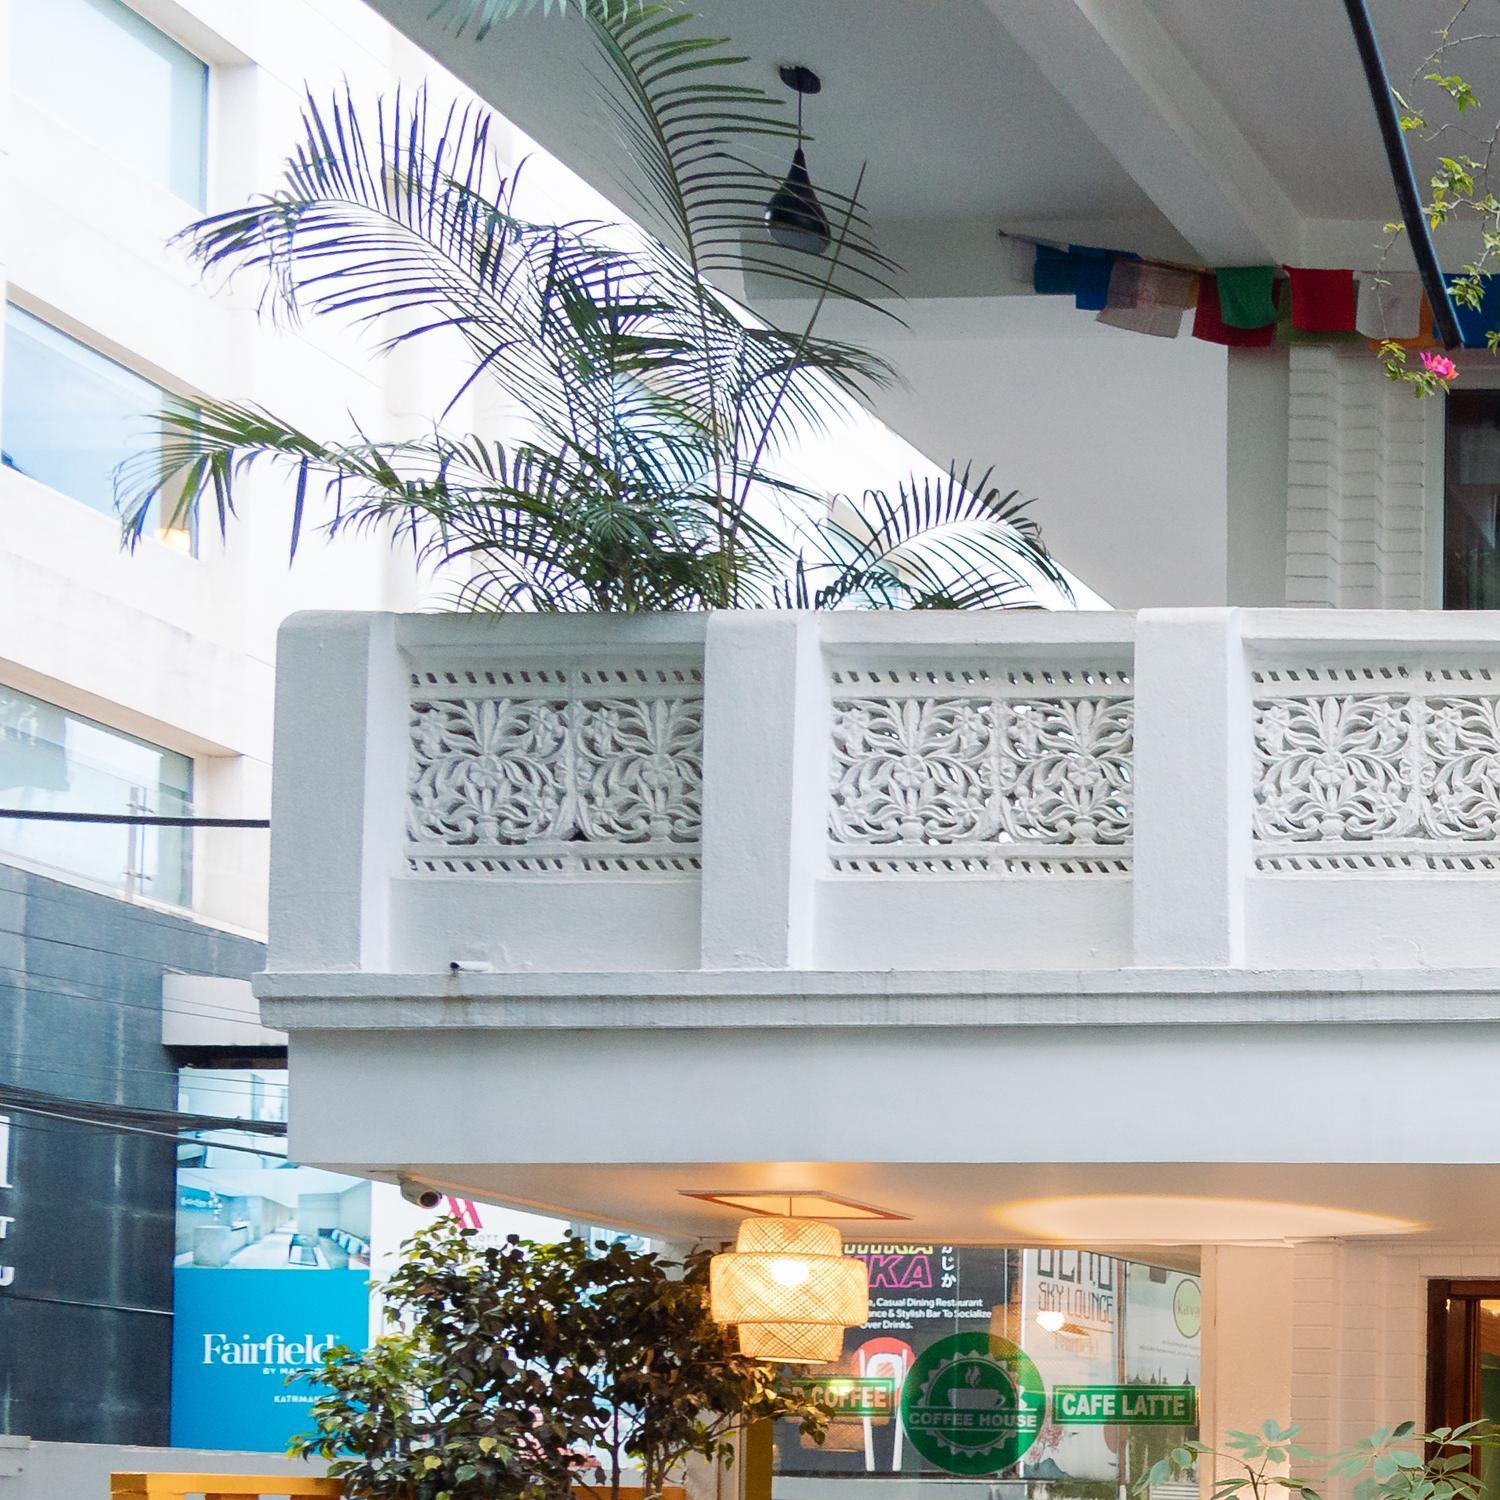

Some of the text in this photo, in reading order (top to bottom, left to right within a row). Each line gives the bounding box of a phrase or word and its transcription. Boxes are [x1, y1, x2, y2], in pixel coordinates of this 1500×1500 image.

[876, 1298, 983, 1309] Casual Dining Restaurant
[896, 1309, 925, 1320] Stylish
[926, 1309, 941, 1318] Bar
[203, 1333, 335, 1365] Fairfield
[1062, 1394, 1185, 1416] CAFE LATTE
[909, 1412, 1037, 1428] COFFEE HOUSE
